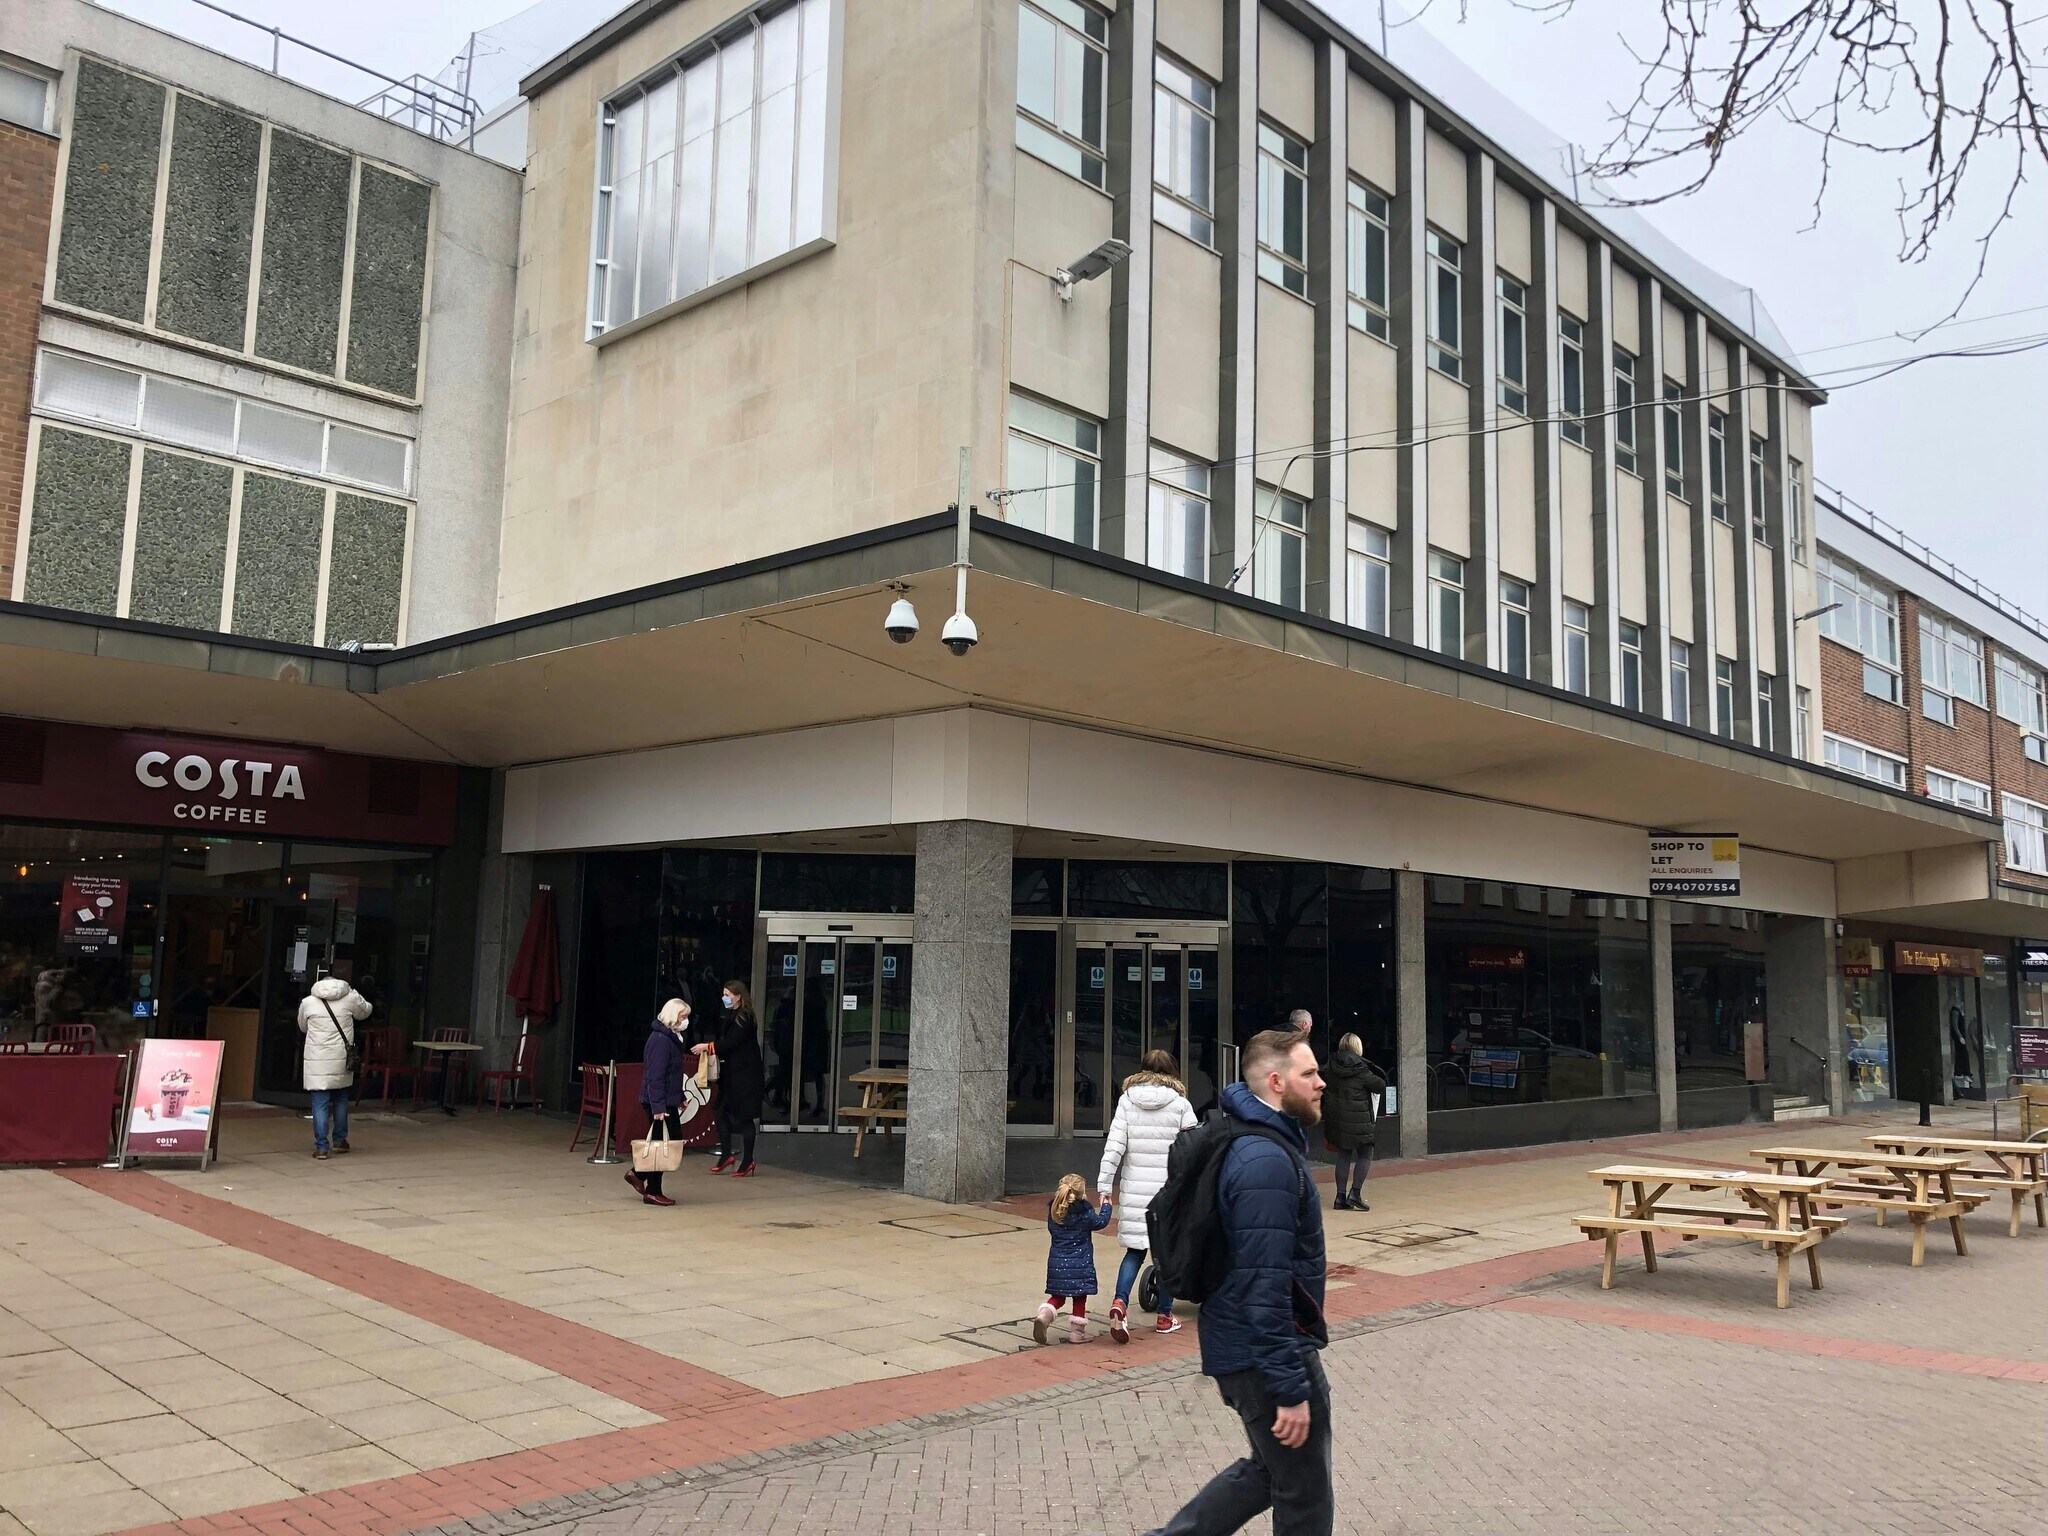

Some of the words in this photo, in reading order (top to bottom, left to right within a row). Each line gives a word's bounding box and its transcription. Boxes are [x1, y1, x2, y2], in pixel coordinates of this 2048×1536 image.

[135, 751, 306, 800] COSTA
[173, 803, 267, 825] COFFEE
[1651, 842, 1684, 851] SHOP
[1688, 842, 1705, 851] TO
[1651, 856, 1674, 865] LET
[73, 875, 100, 883] Introducing
[1651, 883, 1736, 892] 07940707554
[1902, 950, 1913, 965] The
[1914, 951, 1940, 971] Edinburgh
